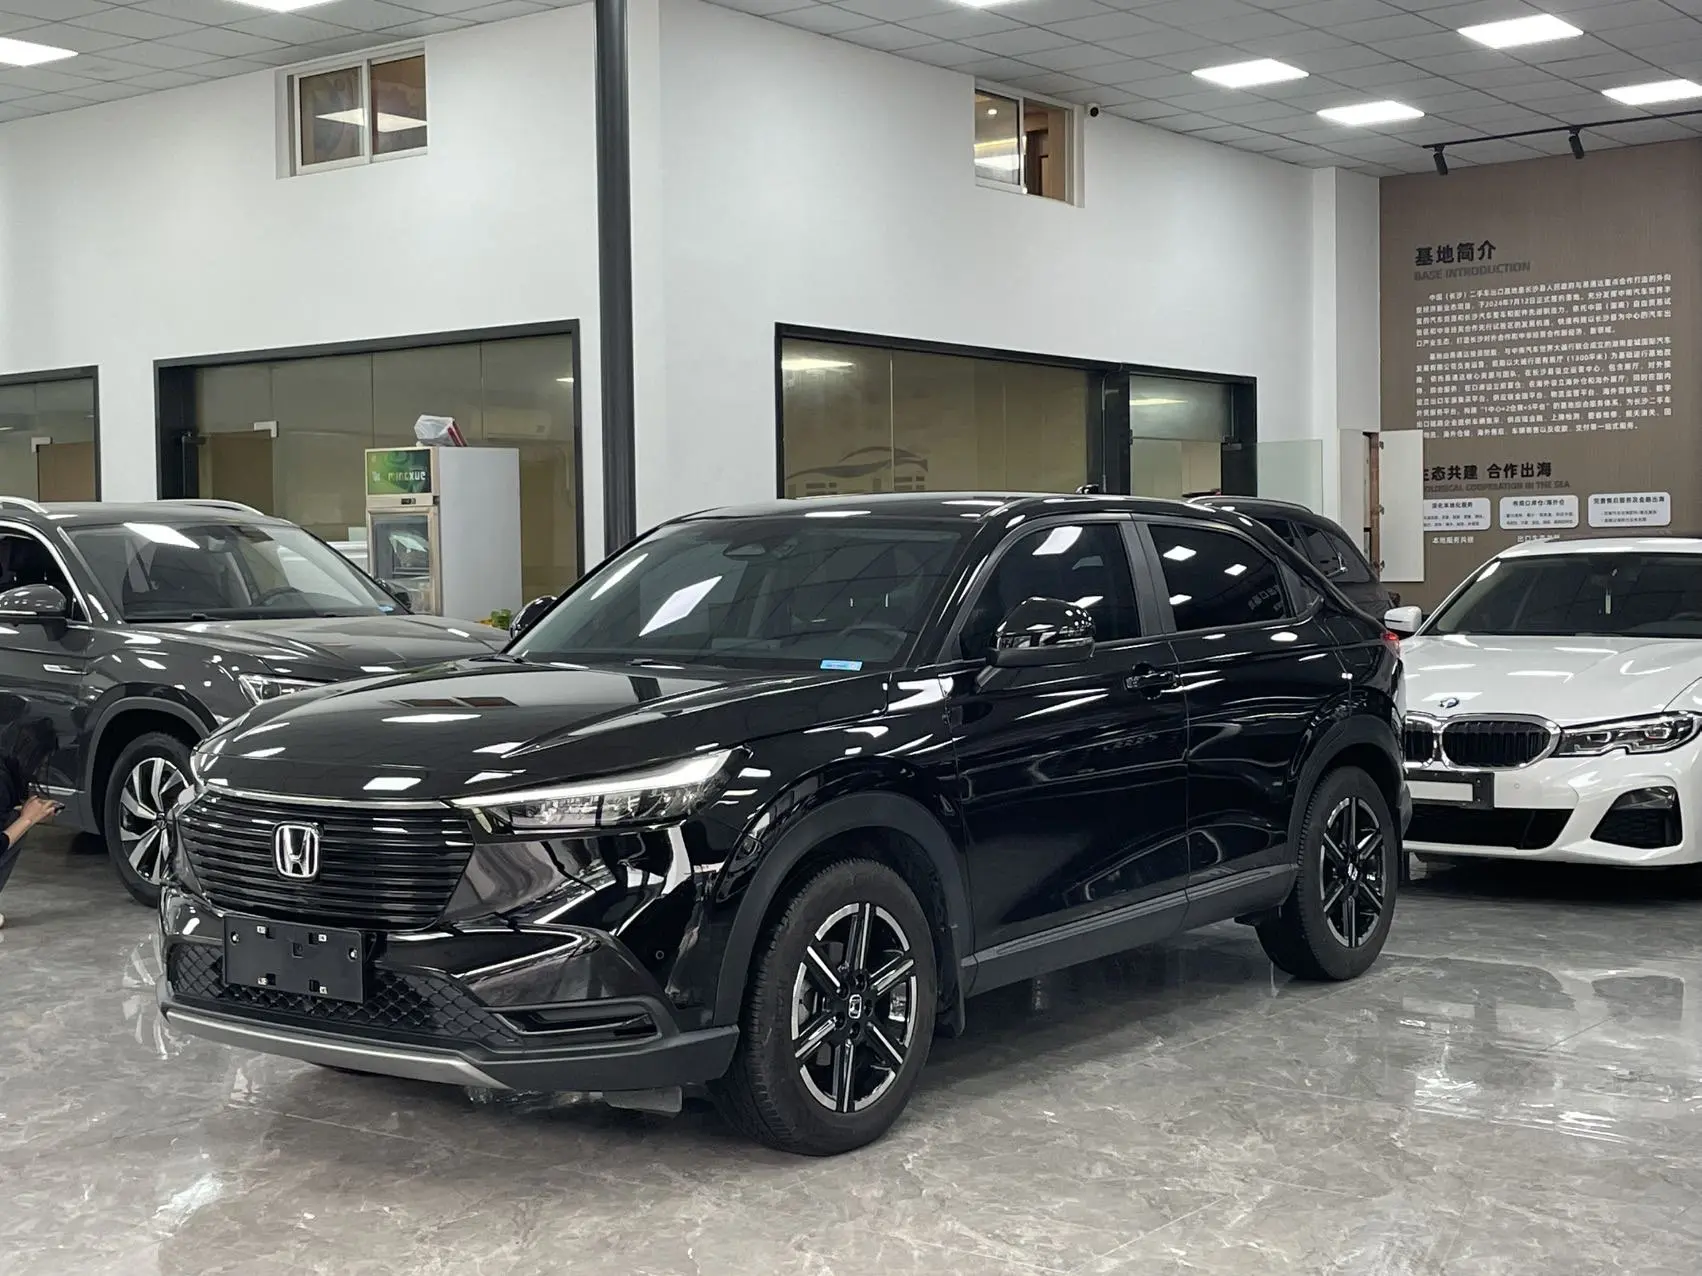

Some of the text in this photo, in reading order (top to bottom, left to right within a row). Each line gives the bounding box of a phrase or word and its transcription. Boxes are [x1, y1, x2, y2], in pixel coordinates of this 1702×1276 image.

[1415, 240, 1496, 266] 基地简介
[1414, 261, 1531, 281] BASE INTRODUCTION
[1487, 462, 1552, 479] 合作出海
